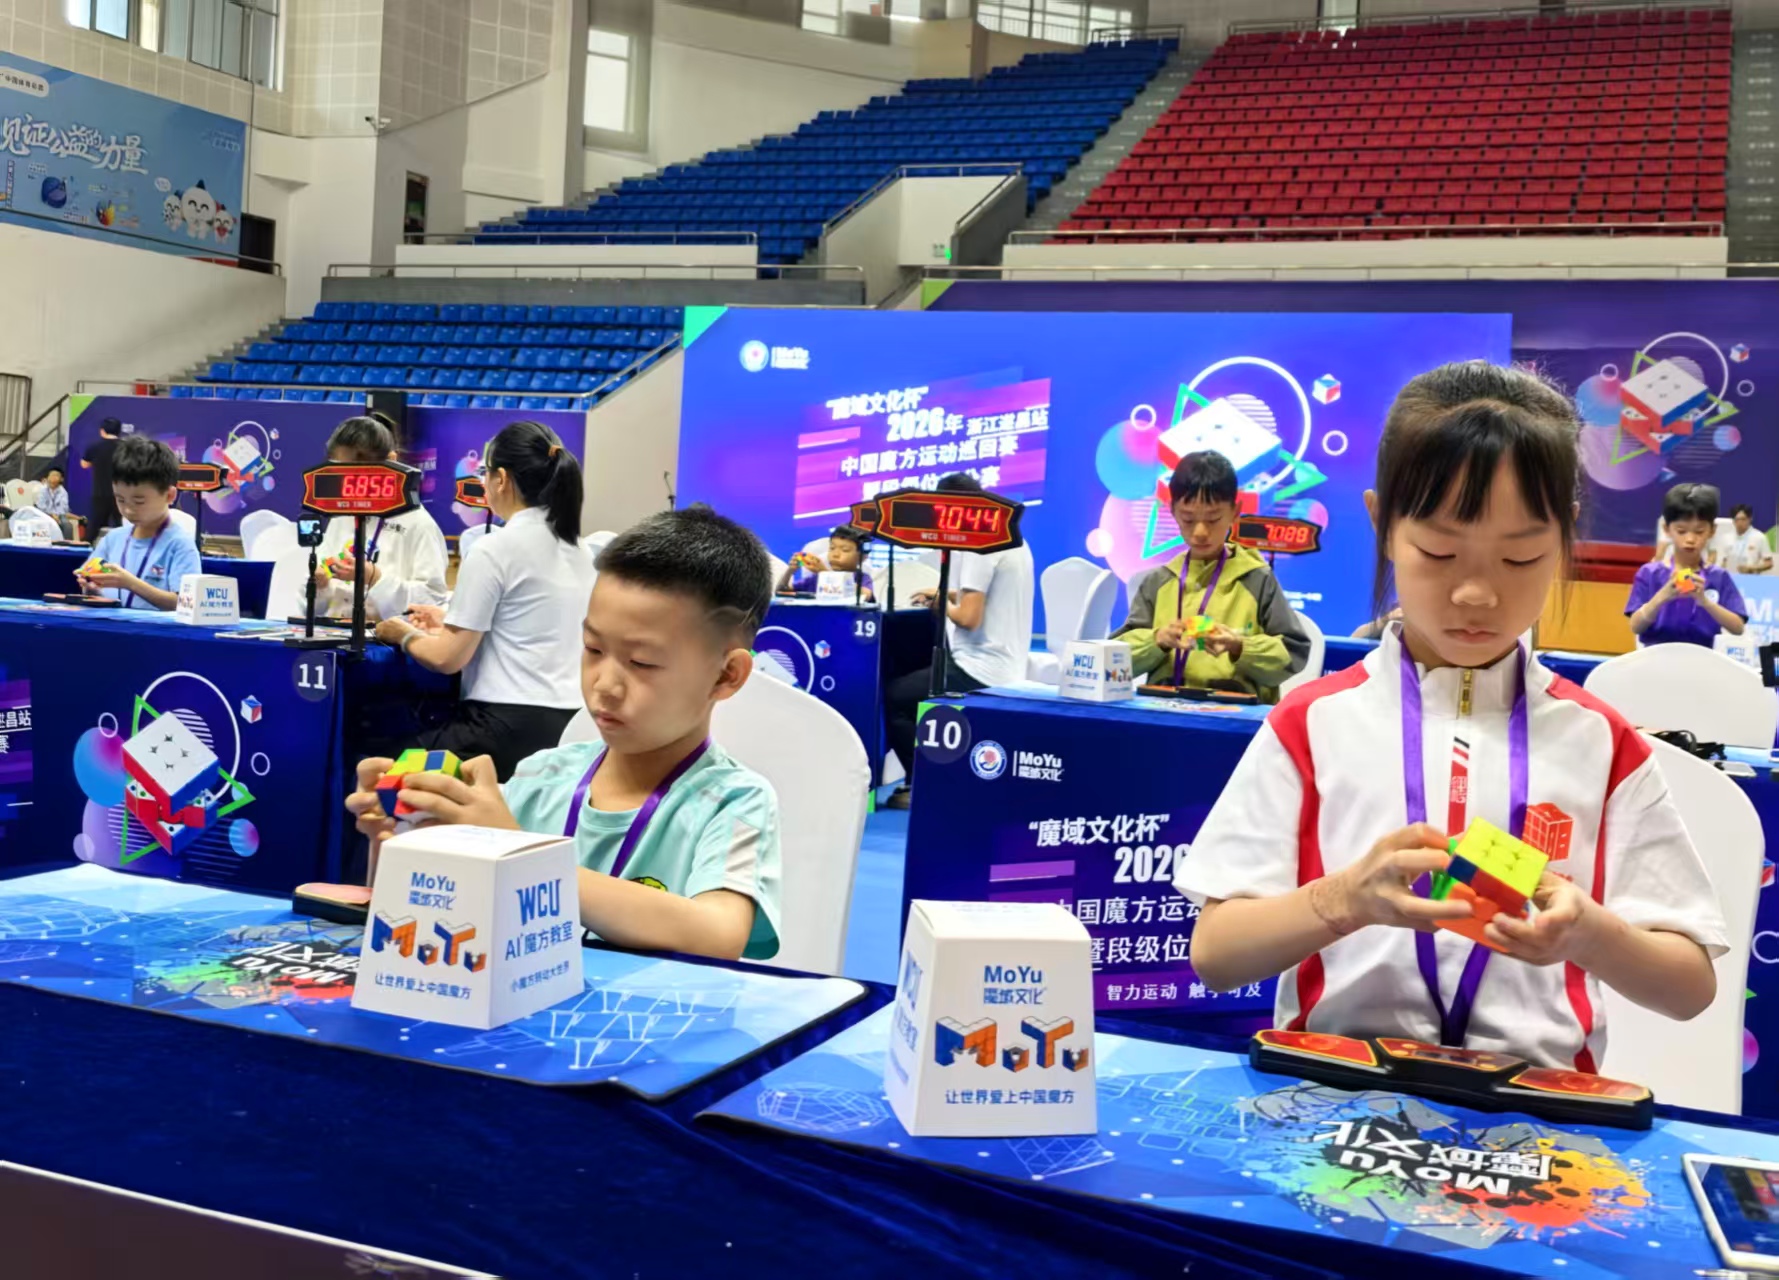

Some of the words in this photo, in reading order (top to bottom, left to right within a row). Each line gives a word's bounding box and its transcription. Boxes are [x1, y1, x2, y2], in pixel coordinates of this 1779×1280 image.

[854, 620, 876, 637] 19
[298, 663, 327, 690] 11
[922, 719, 962, 750] 10
[1019, 751, 1062, 768] MoYu
[411, 872, 455, 892] MoYu
[516, 879, 562, 926] WCU
[983, 965, 1043, 984] MoYu
[1107, 983, 1178, 1001] 智力运动
[945, 1089, 1075, 1105] 让世界爱上中国魔方
